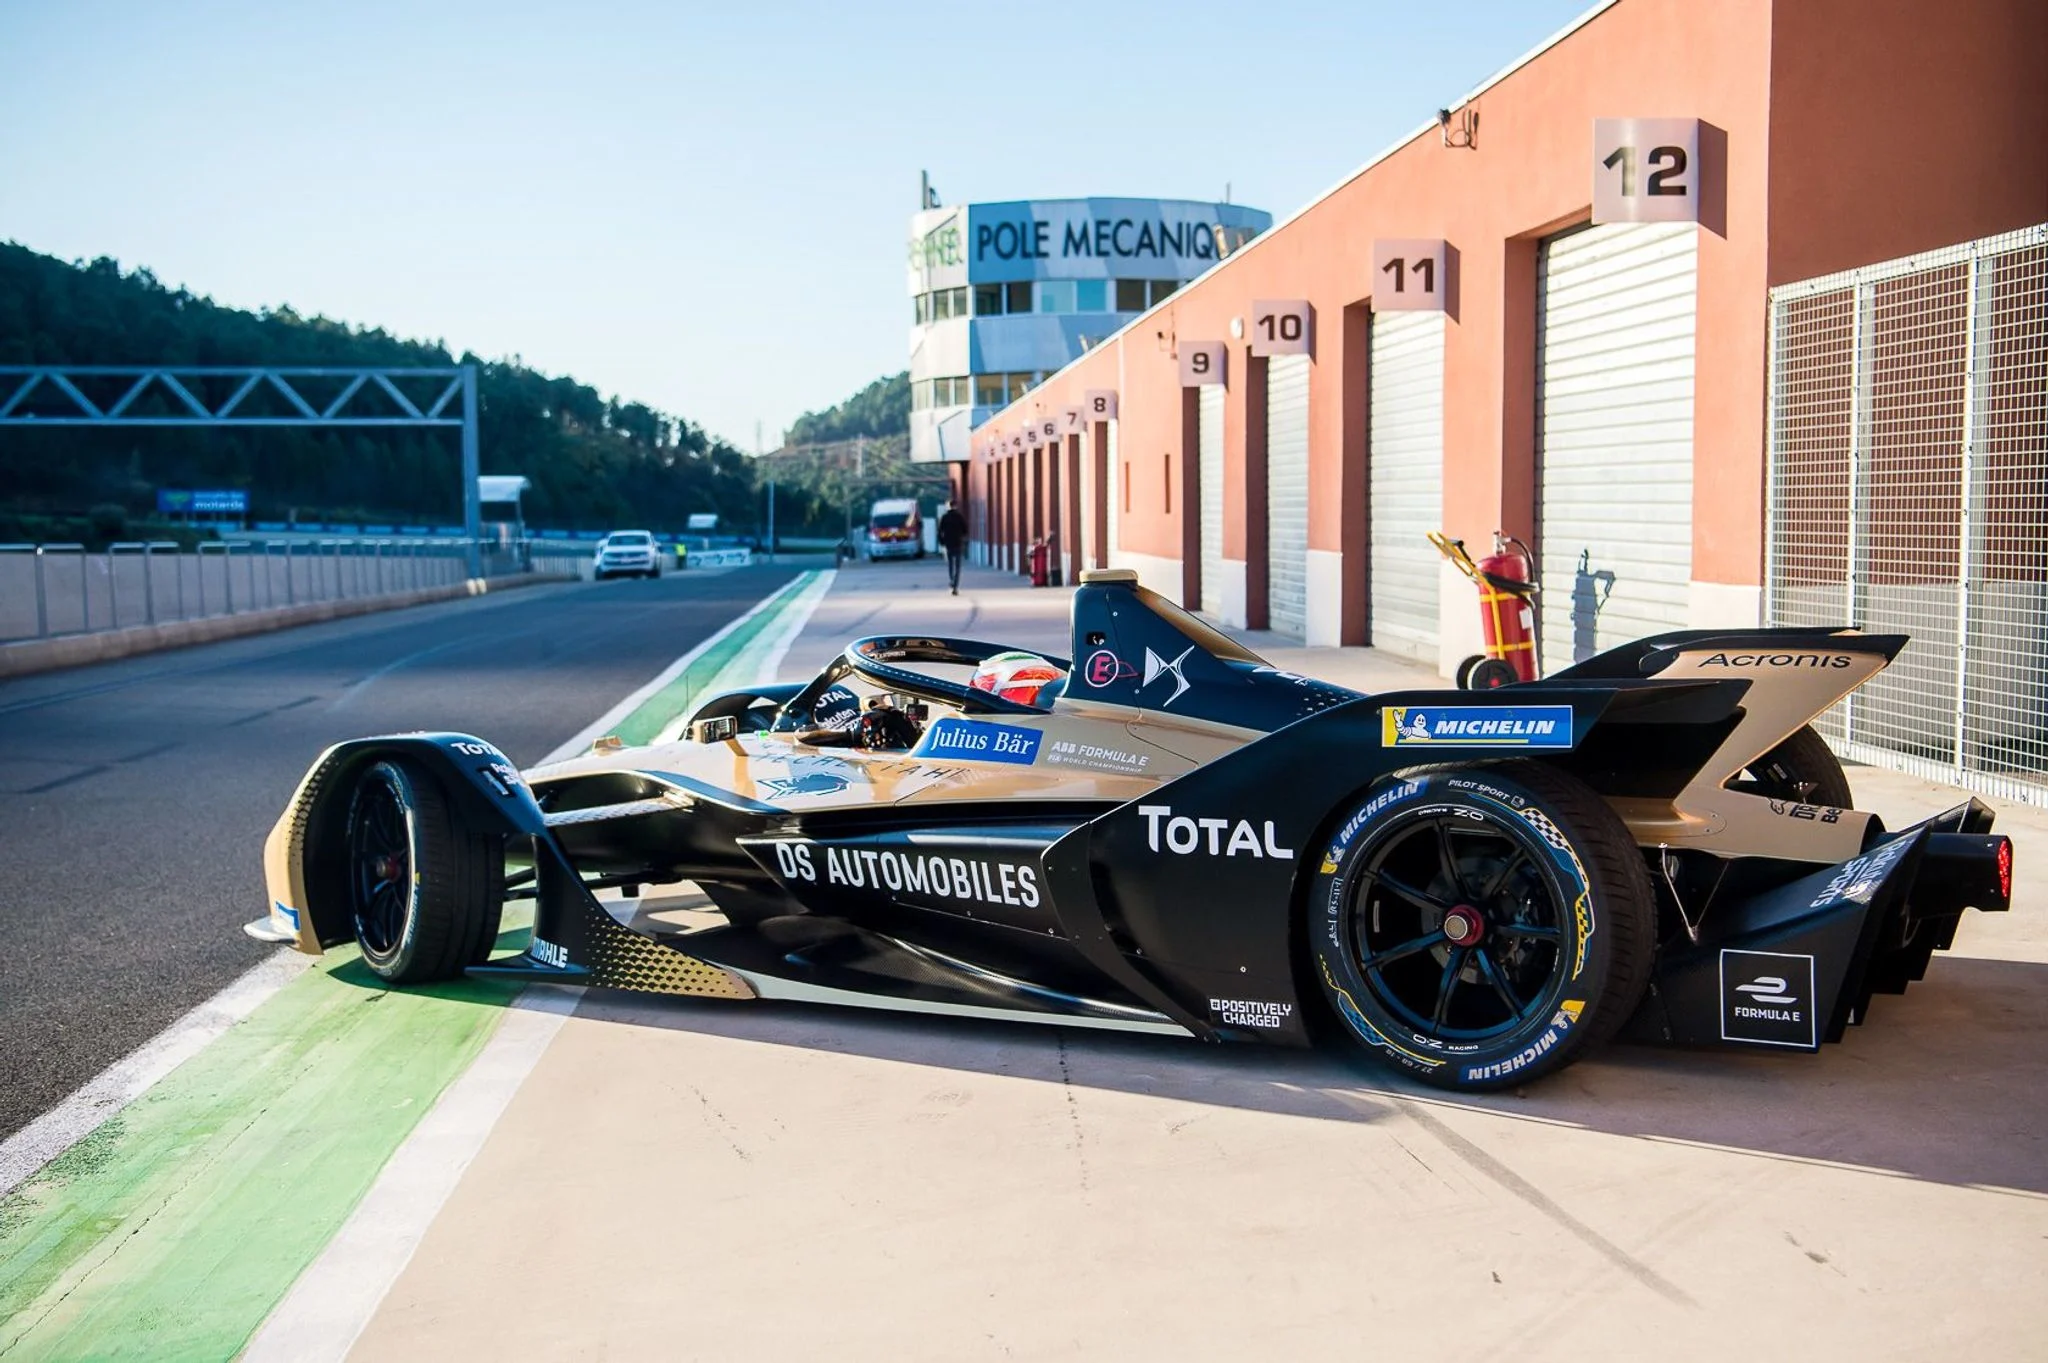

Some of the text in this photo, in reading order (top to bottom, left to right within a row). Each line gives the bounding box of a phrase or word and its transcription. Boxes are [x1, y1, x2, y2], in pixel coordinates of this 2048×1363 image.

[1602, 145, 1687, 197] 12
[977, 219, 1050, 262] POLE
[1062, 219, 1220, 261] MECANIQ
[1382, 257, 1434, 293] 11
[1258, 314, 1301, 341] 10
[1191, 352, 1209, 374] 9
[1093, 397, 1106, 412] 8
[1043, 423, 1054, 436] 6
[1066, 412, 1077, 426] 7
[1027, 431, 1037, 443] 5
[1698, 653, 1852, 668] Acronis
[815, 690, 853, 708] OTAL
[1434, 719, 1556, 735] MICHELIN
[930, 726, 1034, 755] Julius Bär
[1051, 741, 1149, 767] ABB FORMULA E
[1448, 779, 1510, 801] PILOT SPORT
[1340, 781, 1420, 844] MICHELIN
[1138, 805, 1294, 859] TOTAL
[776, 842, 1040, 908] DS AUTOMOBILES
[1221, 1000, 1292, 1016] POSITIVELY
[1735, 1006, 1801, 1022] FORMULA E
[1223, 1012, 1280, 1028] CHARGED
[1468, 1029, 1559, 1080] MICHELIN
